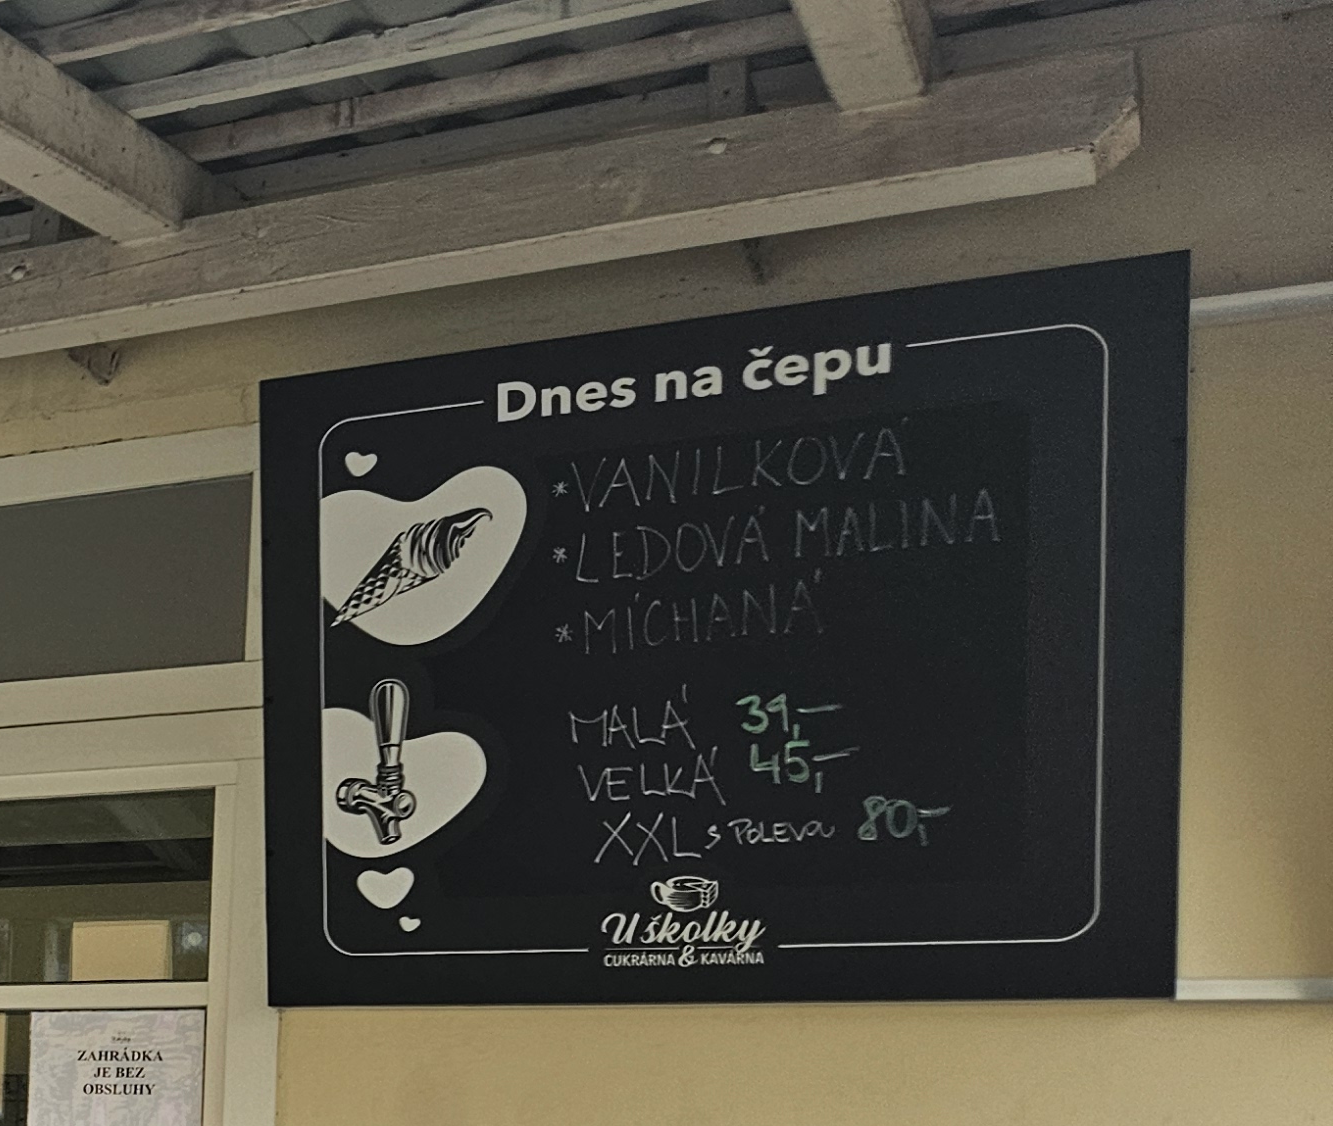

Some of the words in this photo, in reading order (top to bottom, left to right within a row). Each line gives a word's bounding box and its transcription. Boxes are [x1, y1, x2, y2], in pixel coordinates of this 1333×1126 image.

[497, 376, 636, 423] Dnes
[654, 365, 723, 402] na
[742, 343, 892, 396] čepu
[571, 416, 908, 512] VANILKOVÁ
[576, 505, 769, 583] LEDOVÁ
[794, 488, 1001, 558] MALINA
[584, 568, 824, 654] MÍCHANÁ
[568, 683, 696, 750] MALÁ
[578, 746, 726, 805] VELKÁ
[594, 812, 702, 866] XXL
[600, 912, 640, 944] U
[639, 910, 767, 953] školky
[604, 951, 675, 967] CUKRÁRNA
[677, 944, 698, 967] &
[700, 951, 764, 966] KAVÁRNA
[77, 1047, 163, 1062] ZAHRÁDKA
[93, 1067, 111, 1079] JE
[115, 1067, 146, 1078] BEZ
[83, 1083, 155, 1096] OBSLUHY
